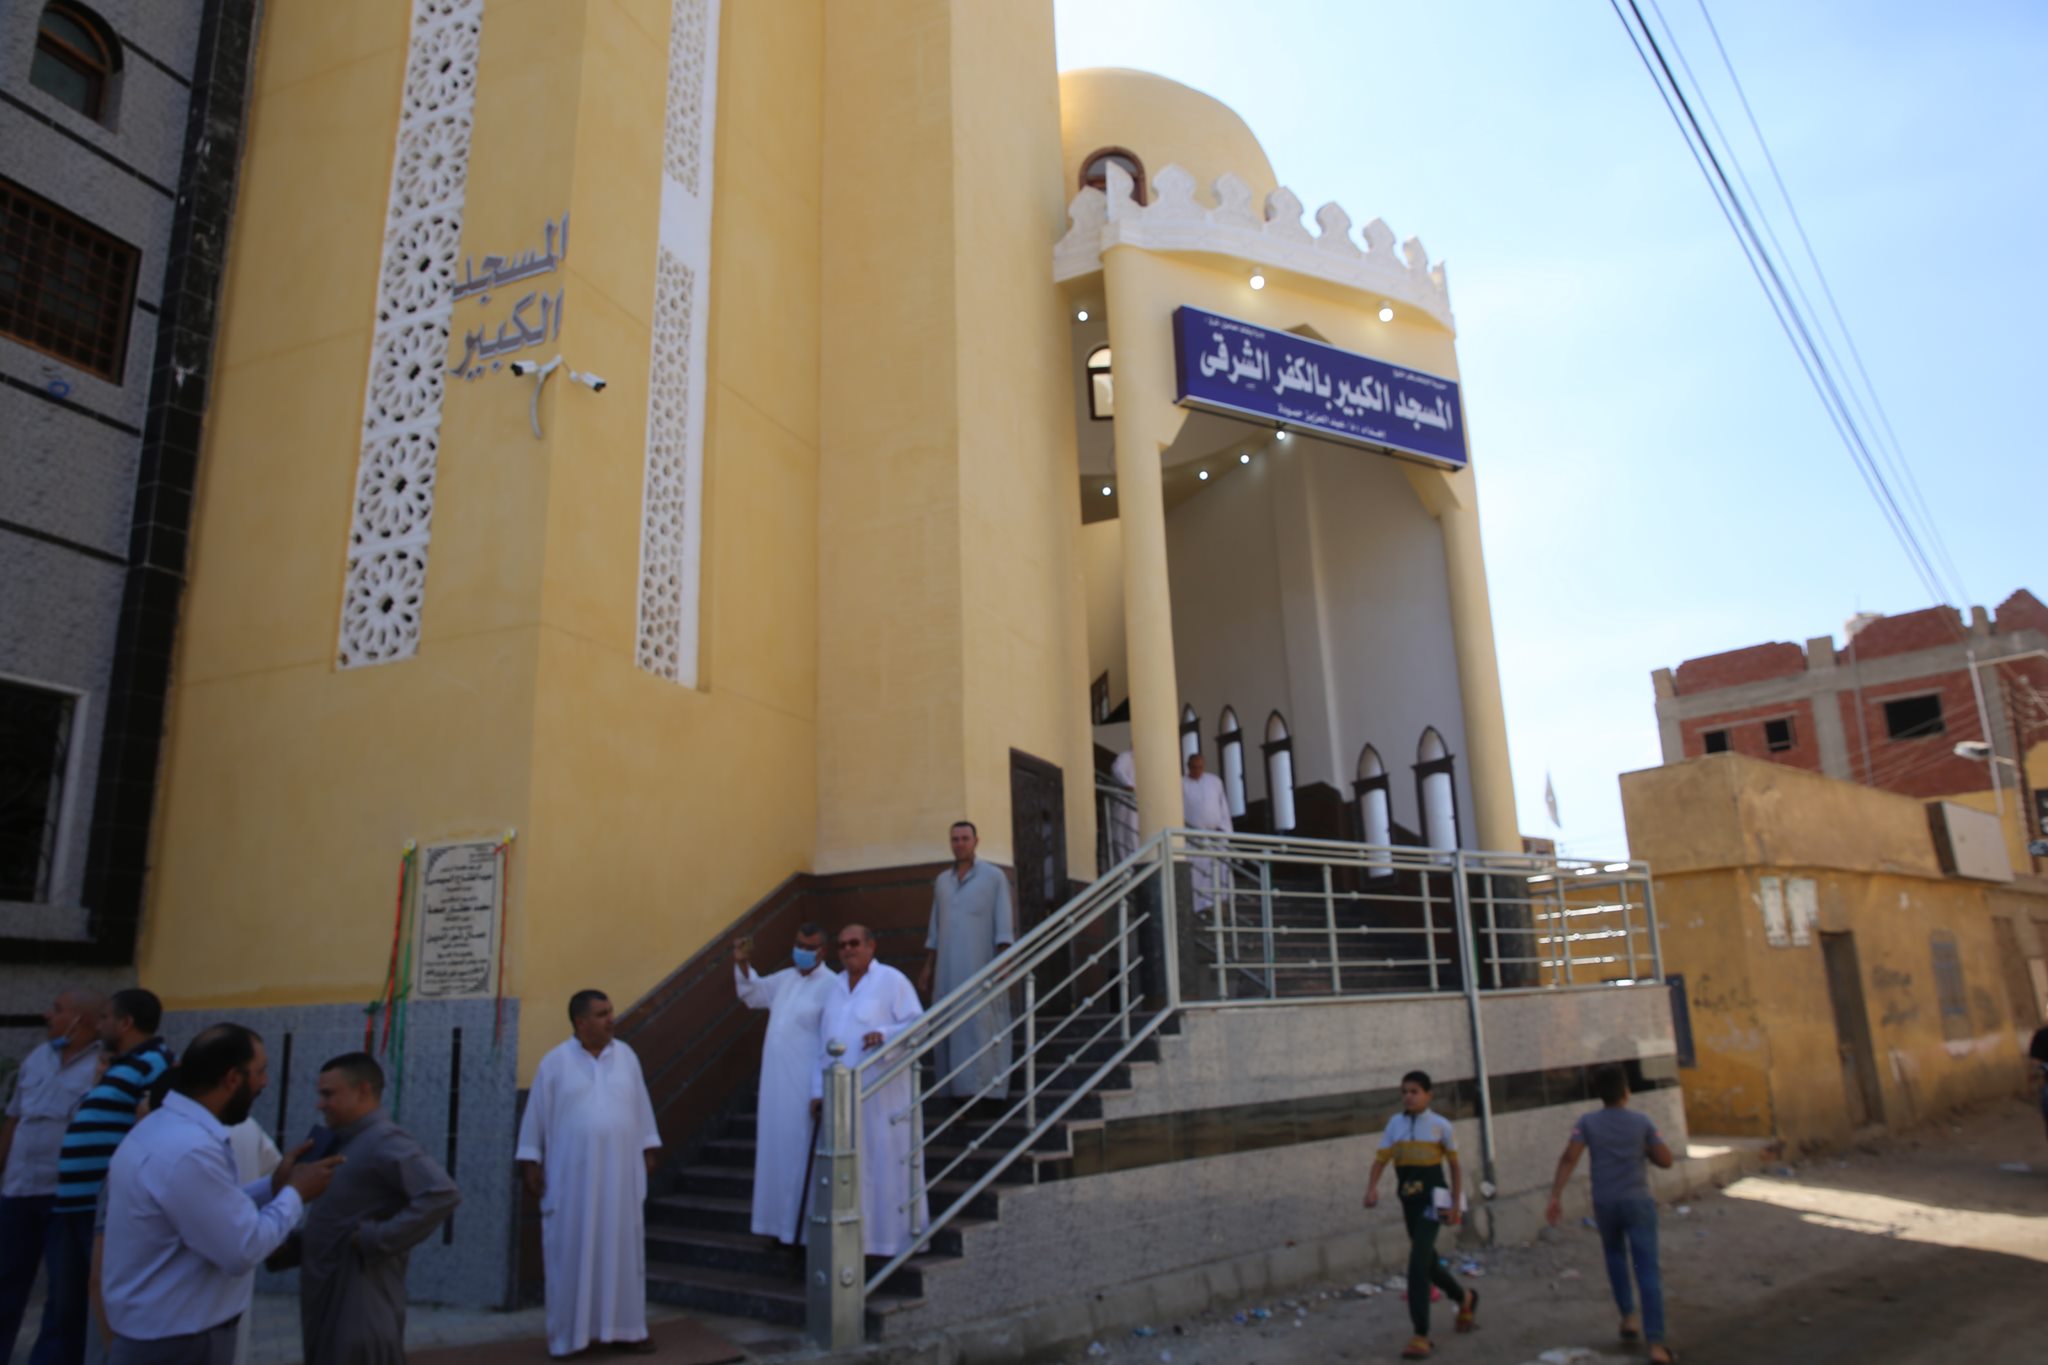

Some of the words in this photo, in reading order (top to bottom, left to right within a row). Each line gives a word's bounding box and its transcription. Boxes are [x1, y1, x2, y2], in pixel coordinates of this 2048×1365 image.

[452, 210, 570, 305] المسجد
[449, 286, 565, 382] الكبير
[1273, 353, 1333, 411] بالكفر
[1332, 375, 1392, 417] الكبير
[1394, 386, 1453, 432] المسجد
